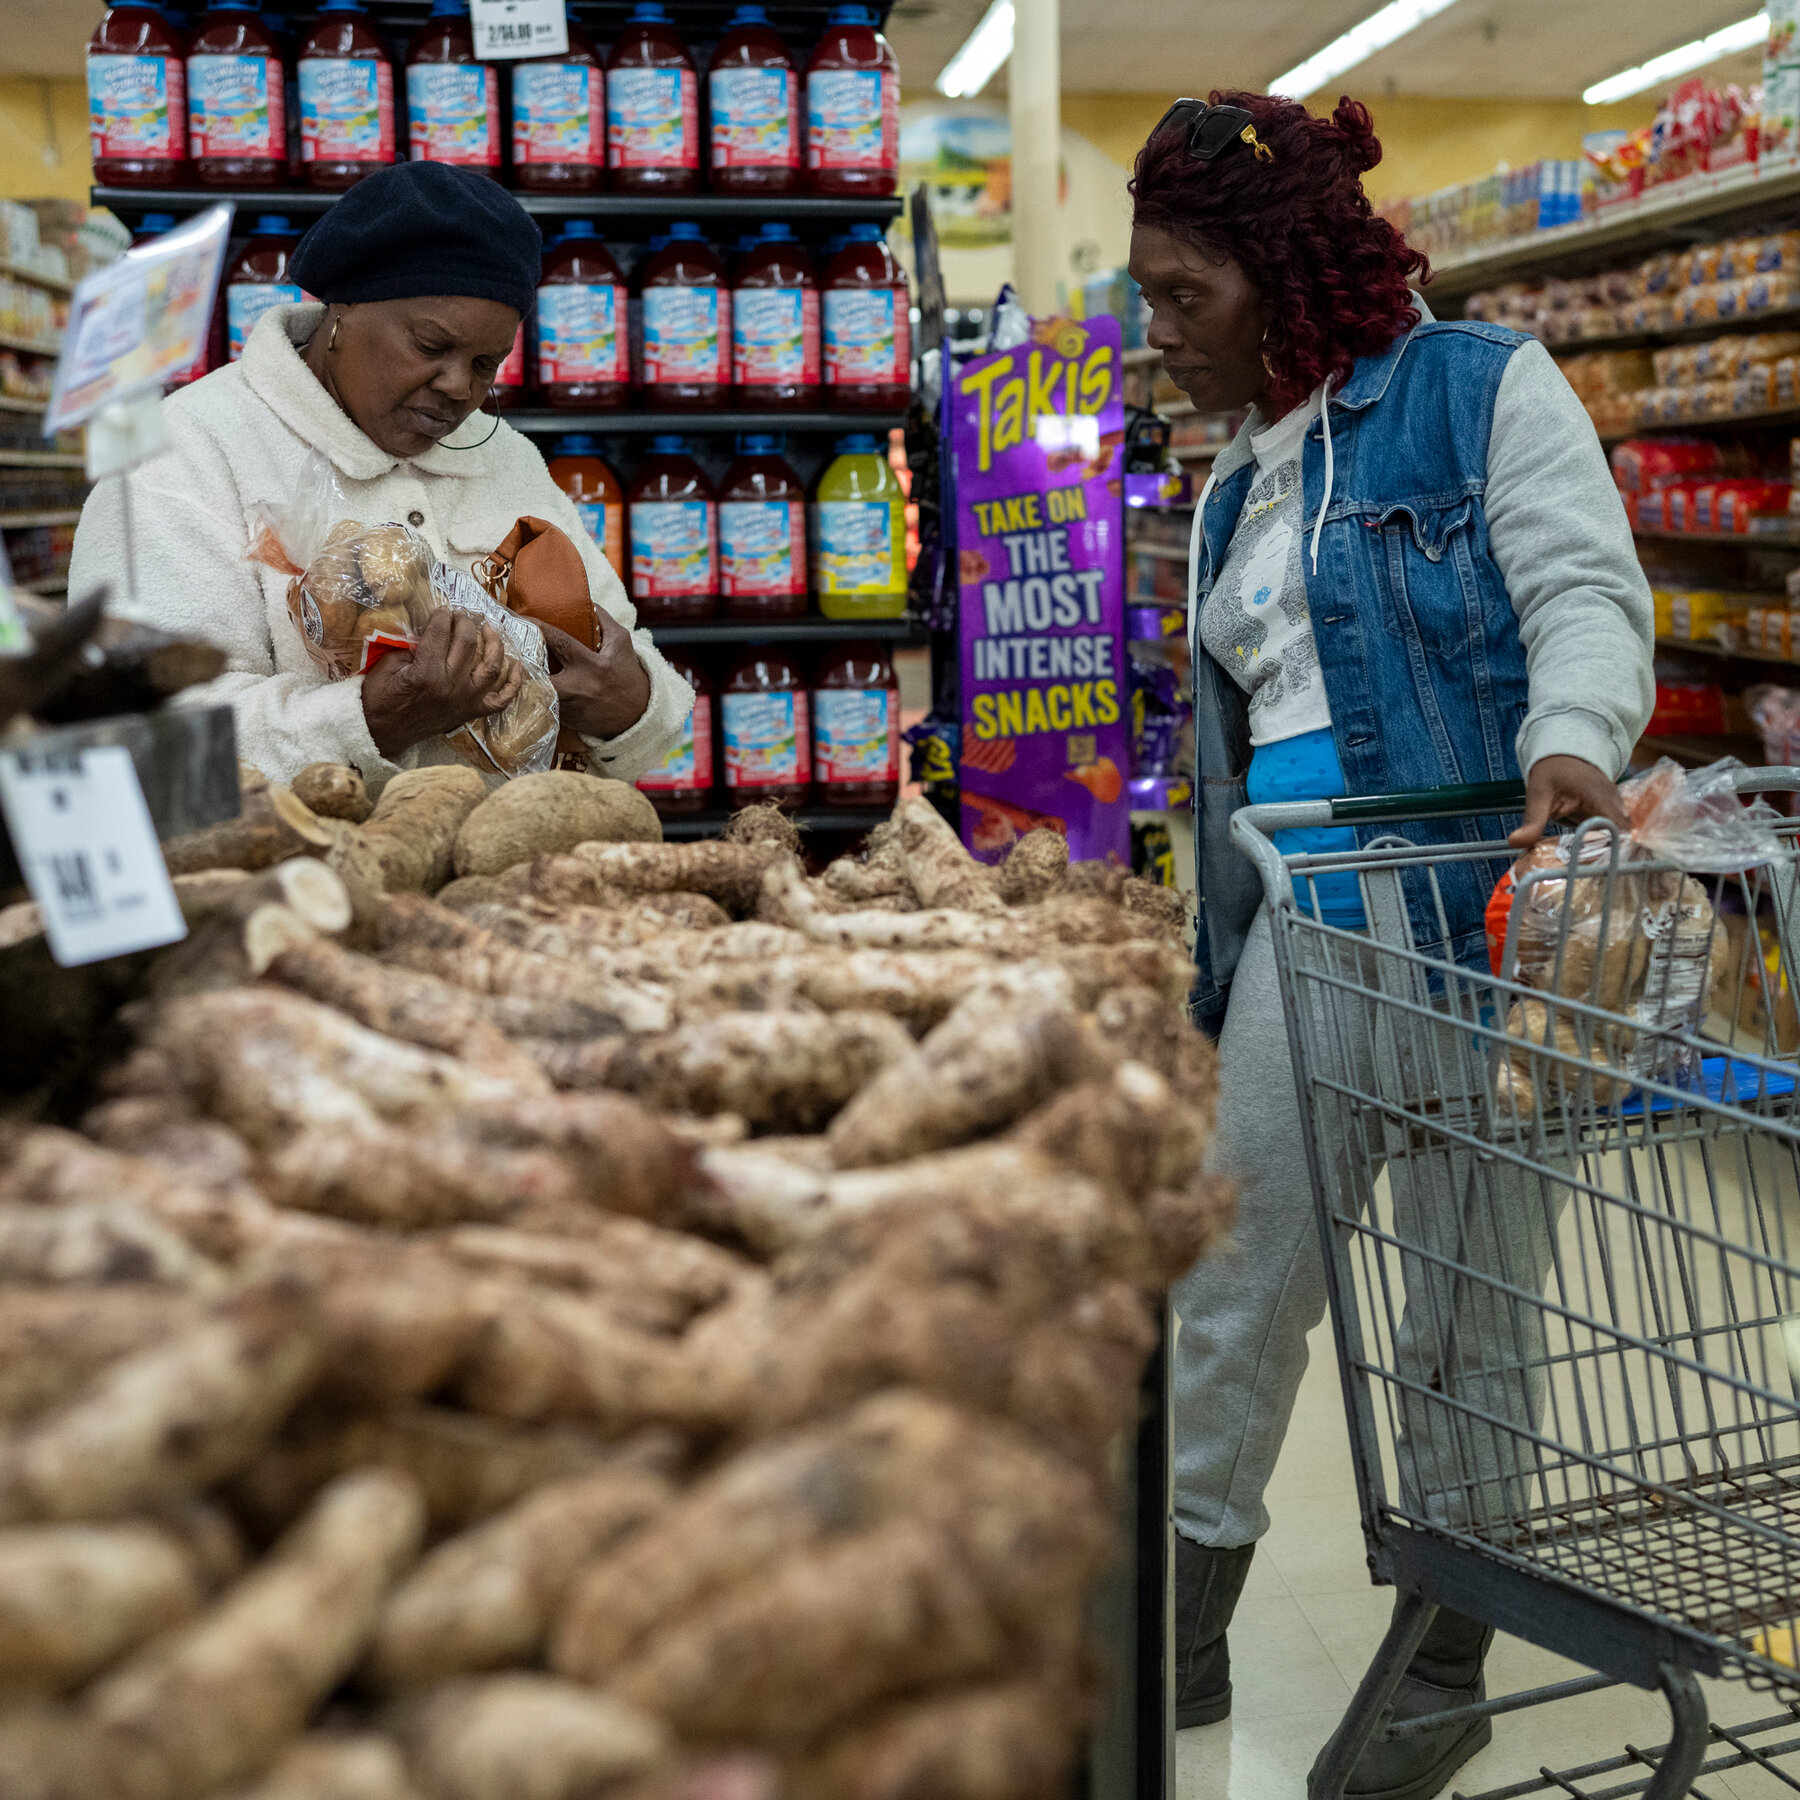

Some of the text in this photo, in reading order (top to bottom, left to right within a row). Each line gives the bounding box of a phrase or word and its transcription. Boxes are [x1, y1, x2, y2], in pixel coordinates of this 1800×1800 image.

[960, 345, 1112, 472] Takis
[973, 487, 1086, 536] TAKE ON
[1003, 530, 1071, 576] THE
[984, 570, 1104, 636] MOST
[974, 634, 1114, 680] INTENSE
[972, 679, 1120, 739] SNACKS
